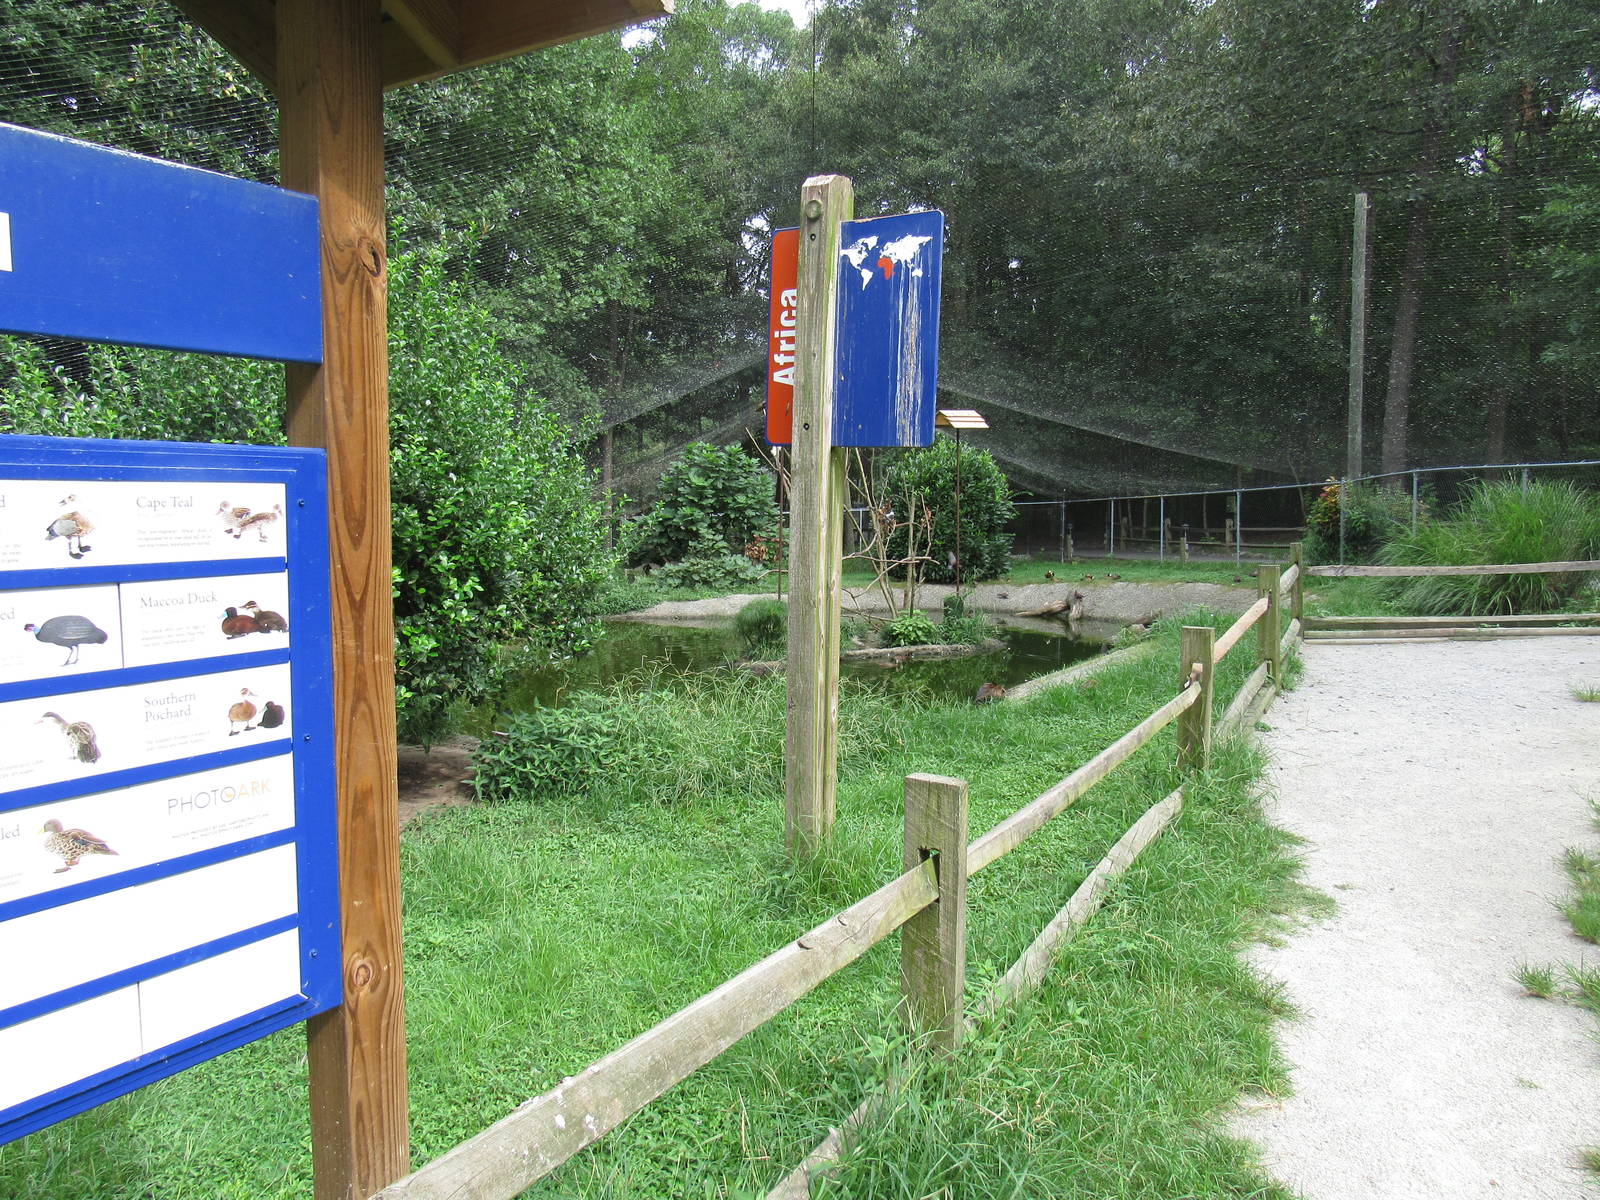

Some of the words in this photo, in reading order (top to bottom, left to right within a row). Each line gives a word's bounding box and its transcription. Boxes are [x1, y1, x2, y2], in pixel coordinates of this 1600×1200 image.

[773, 288, 798, 386] Africa
[136, 496, 167, 512] Cape
[169, 496, 193, 508] Teal
[140, 596, 184, 609] Maccoa
[187, 591, 218, 605] Duck
[143, 692, 197, 708] Southern
[145, 704, 192, 722] Pochard
